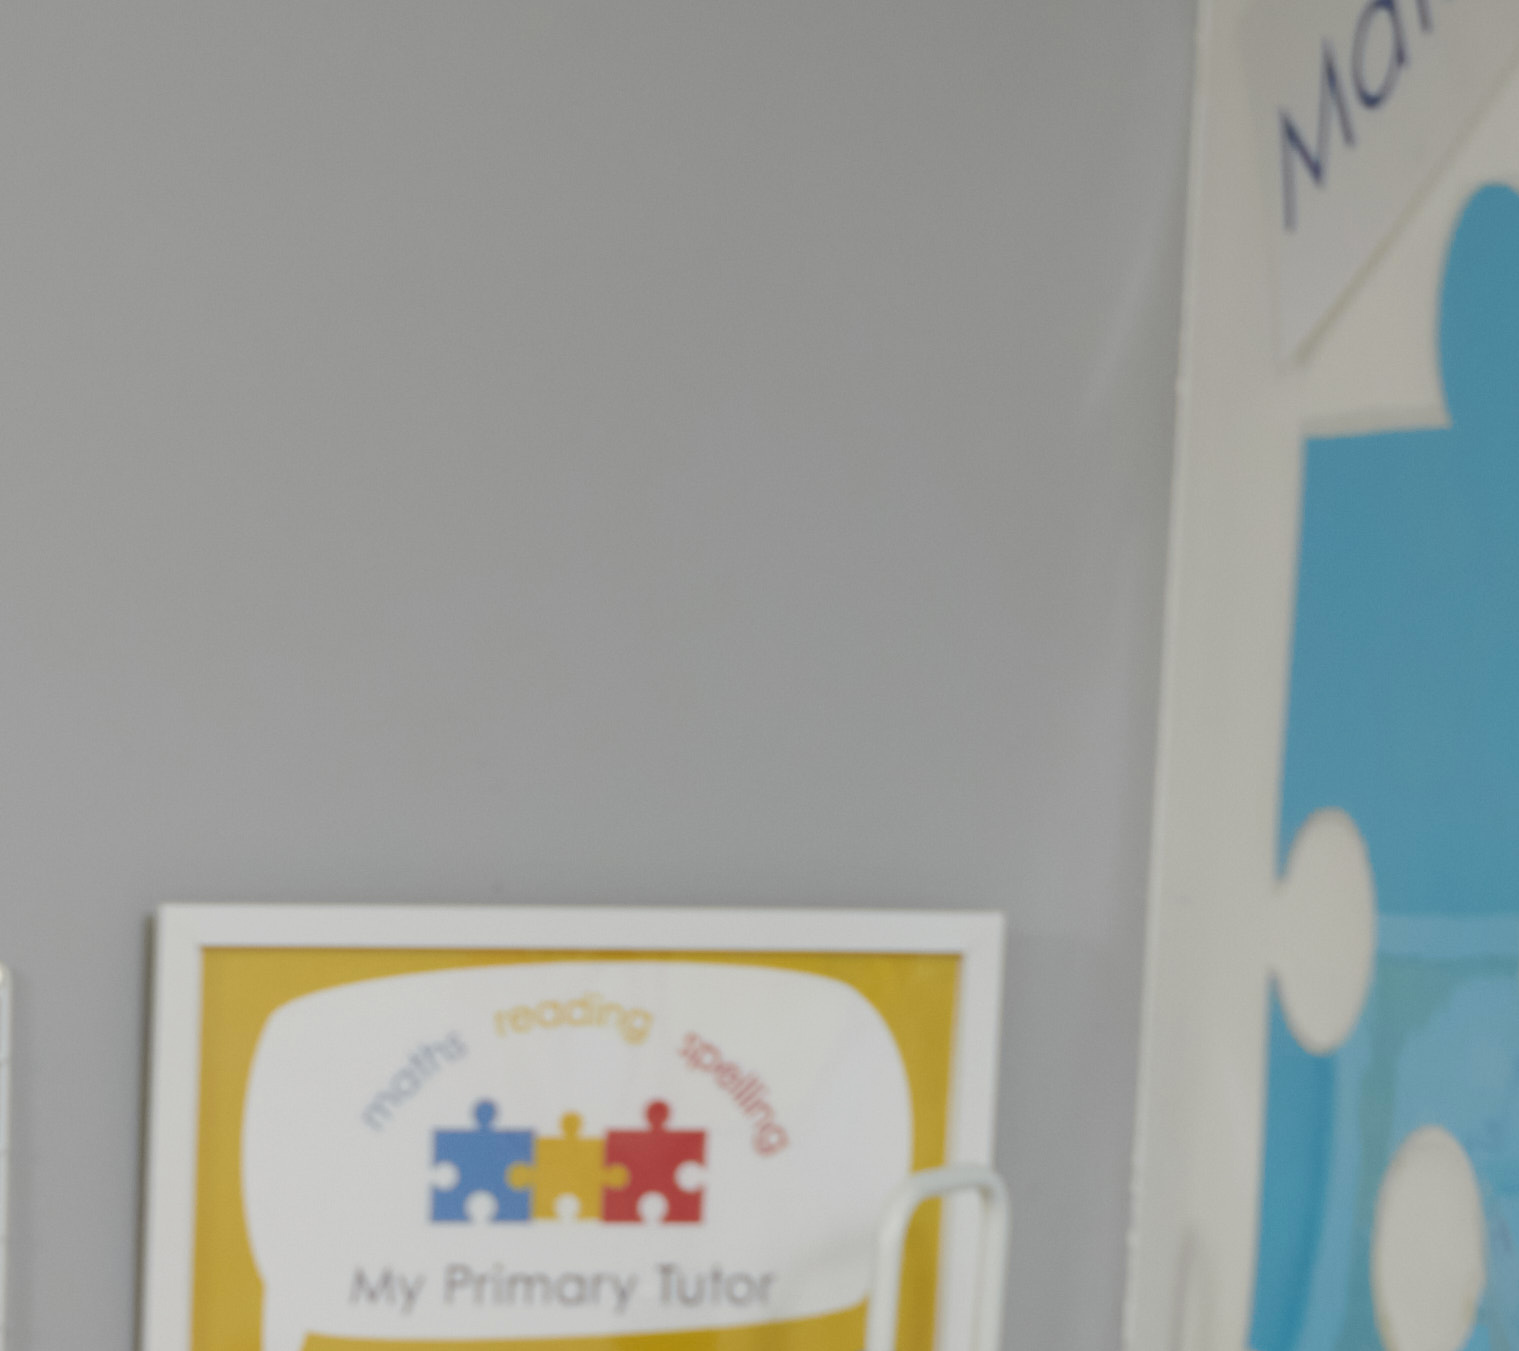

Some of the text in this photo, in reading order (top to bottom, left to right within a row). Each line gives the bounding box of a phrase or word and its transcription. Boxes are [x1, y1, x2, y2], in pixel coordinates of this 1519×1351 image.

[1277, 0, 1434, 235] Ma
[492, 991, 653, 1047] reading
[361, 1030, 470, 1132] maths
[676, 1030, 790, 1157] spelling
[349, 1260, 778, 1316] My Primary Tutor
